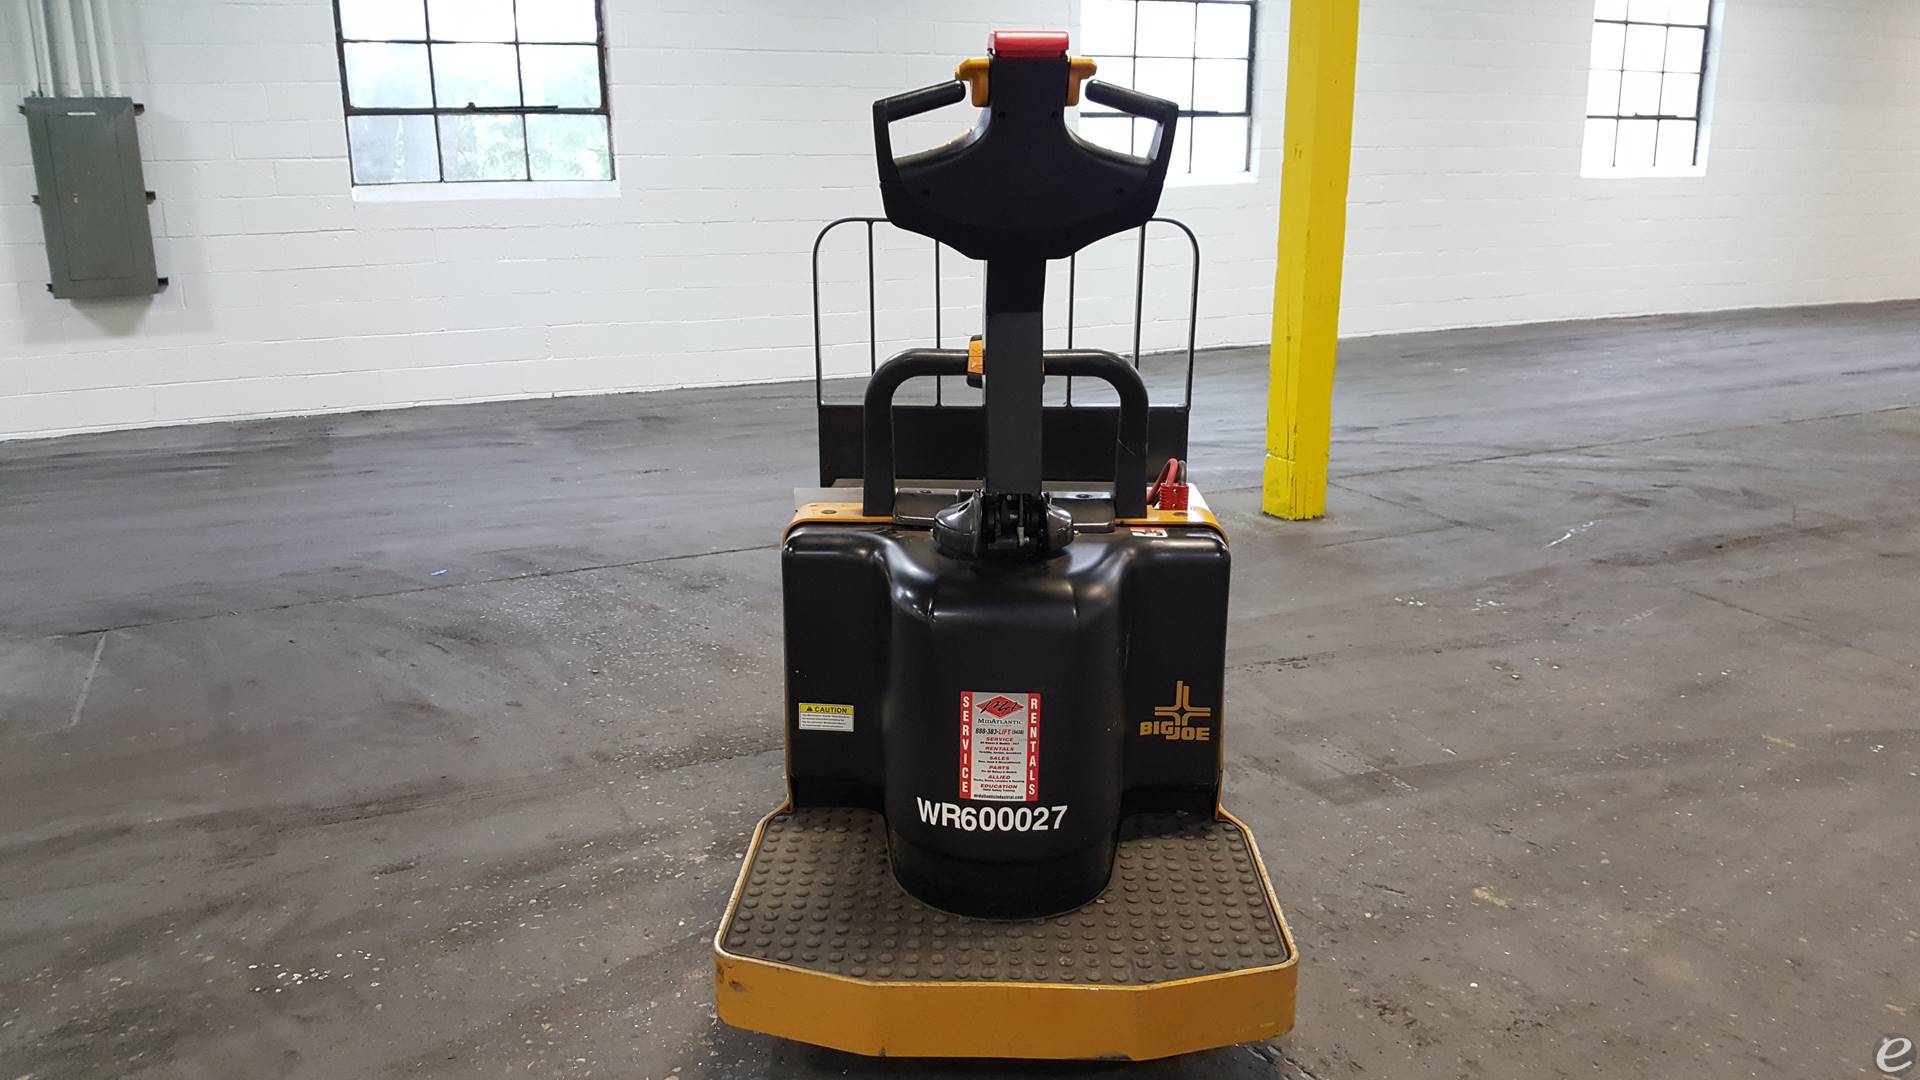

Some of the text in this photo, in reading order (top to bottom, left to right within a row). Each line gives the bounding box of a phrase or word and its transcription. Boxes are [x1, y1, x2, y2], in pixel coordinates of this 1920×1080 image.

[962, 696, 970, 793] SERVICE
[1028, 698, 1038, 795] RENTALS
[916, 796, 1069, 832] WR600027
